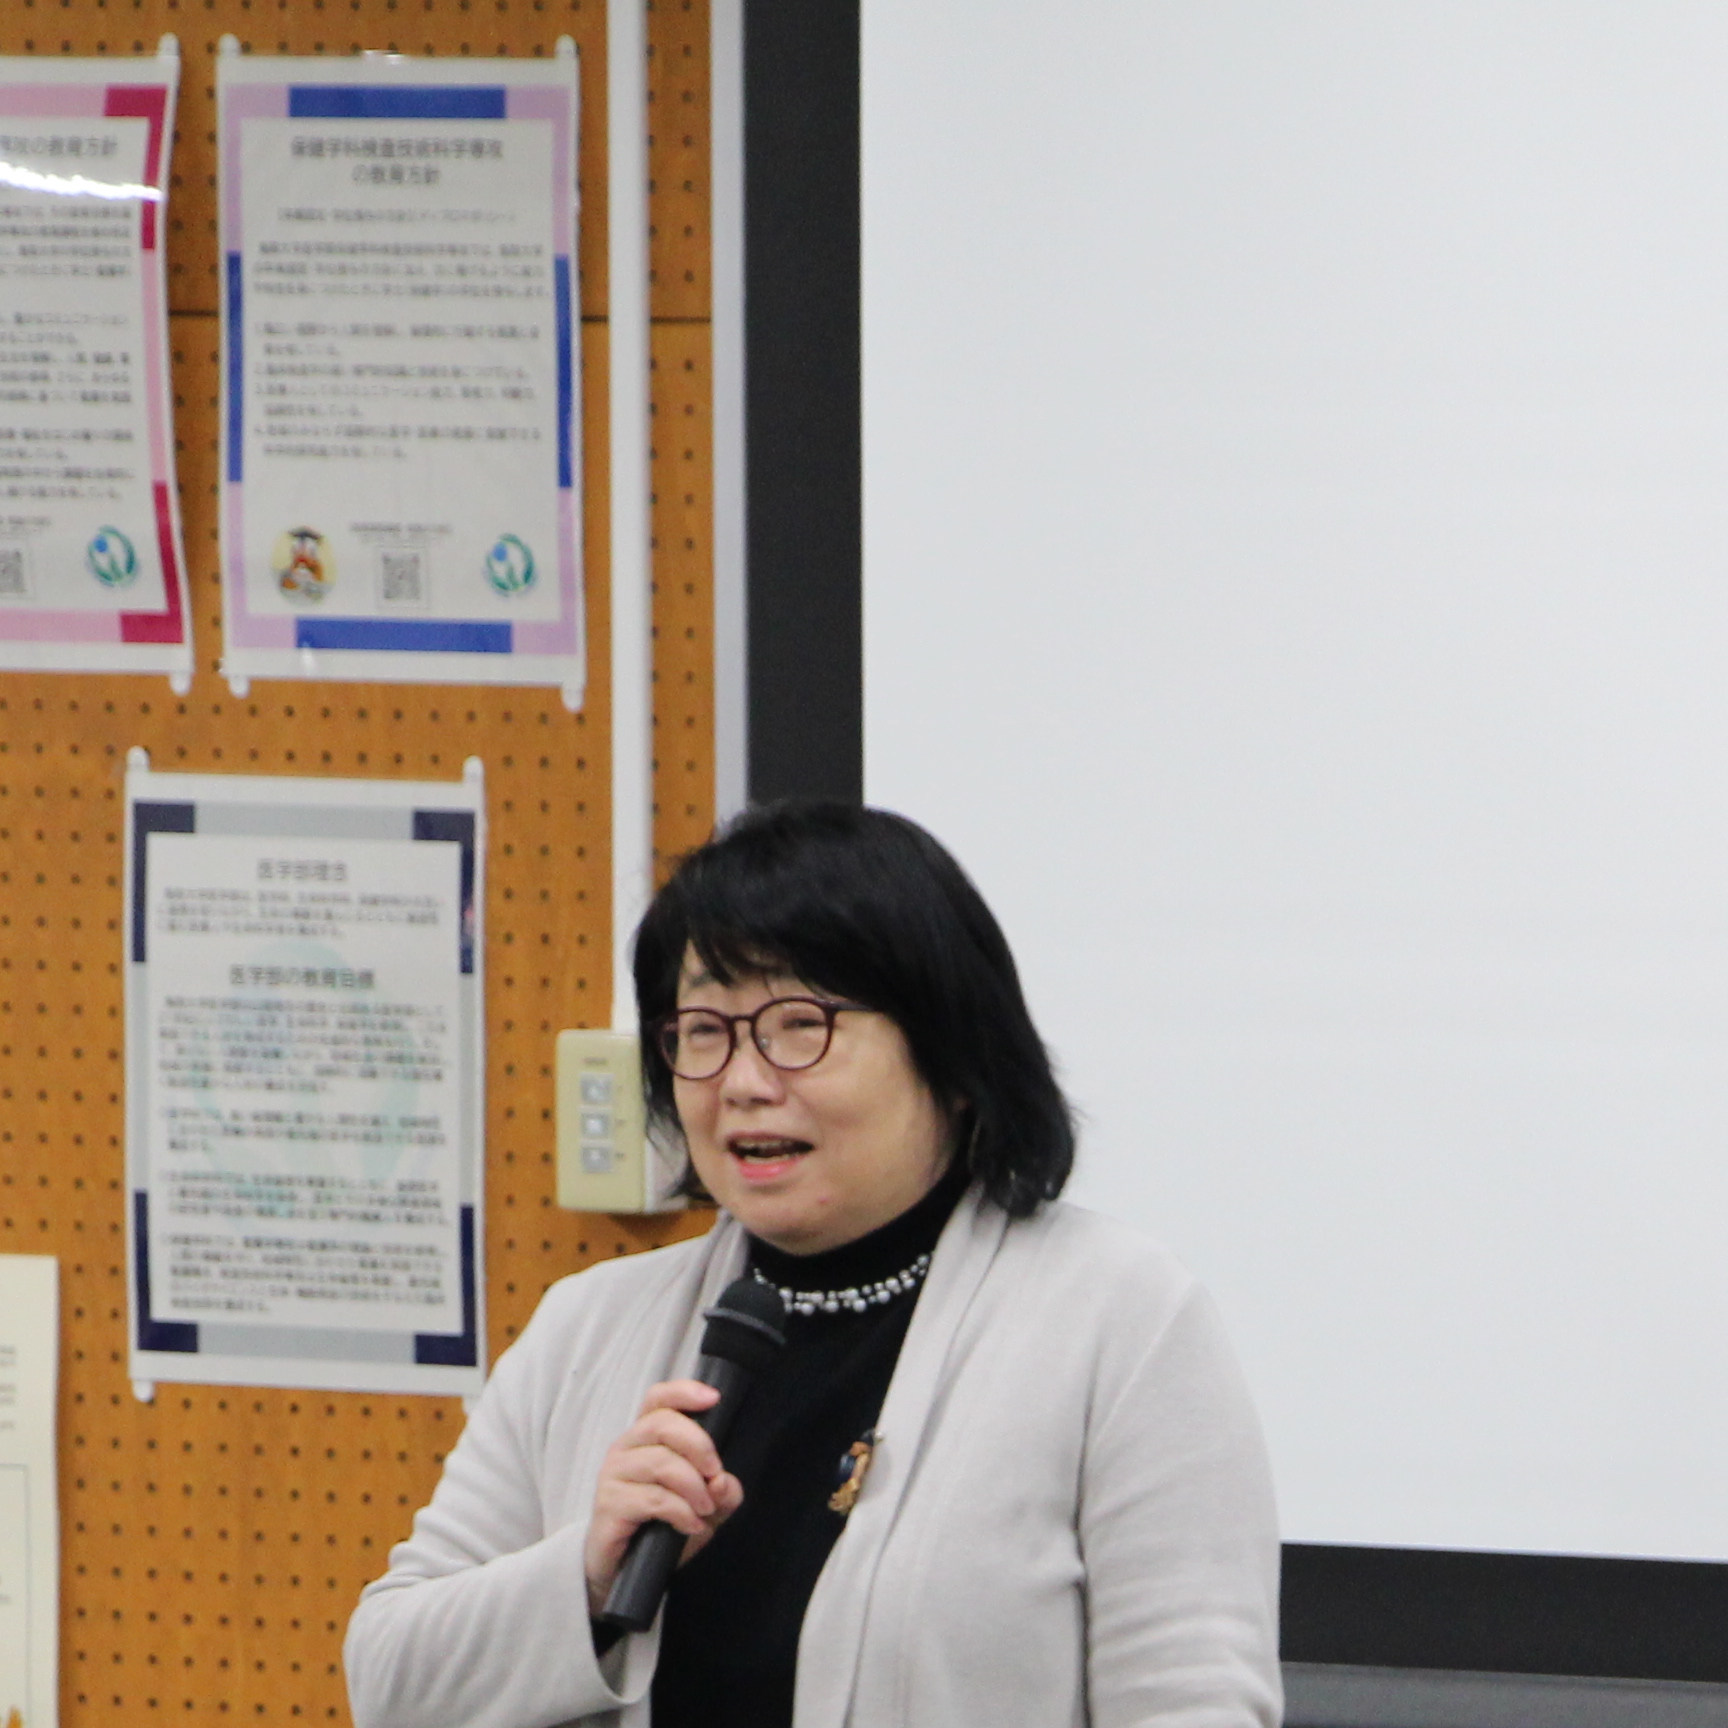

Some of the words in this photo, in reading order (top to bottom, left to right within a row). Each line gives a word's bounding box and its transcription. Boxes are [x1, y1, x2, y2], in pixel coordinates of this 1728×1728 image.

[352, 164, 441, 185] の教育方針
[256, 858, 348, 883] 医学部理念
[229, 965, 375, 989] 医学部の教育目標
